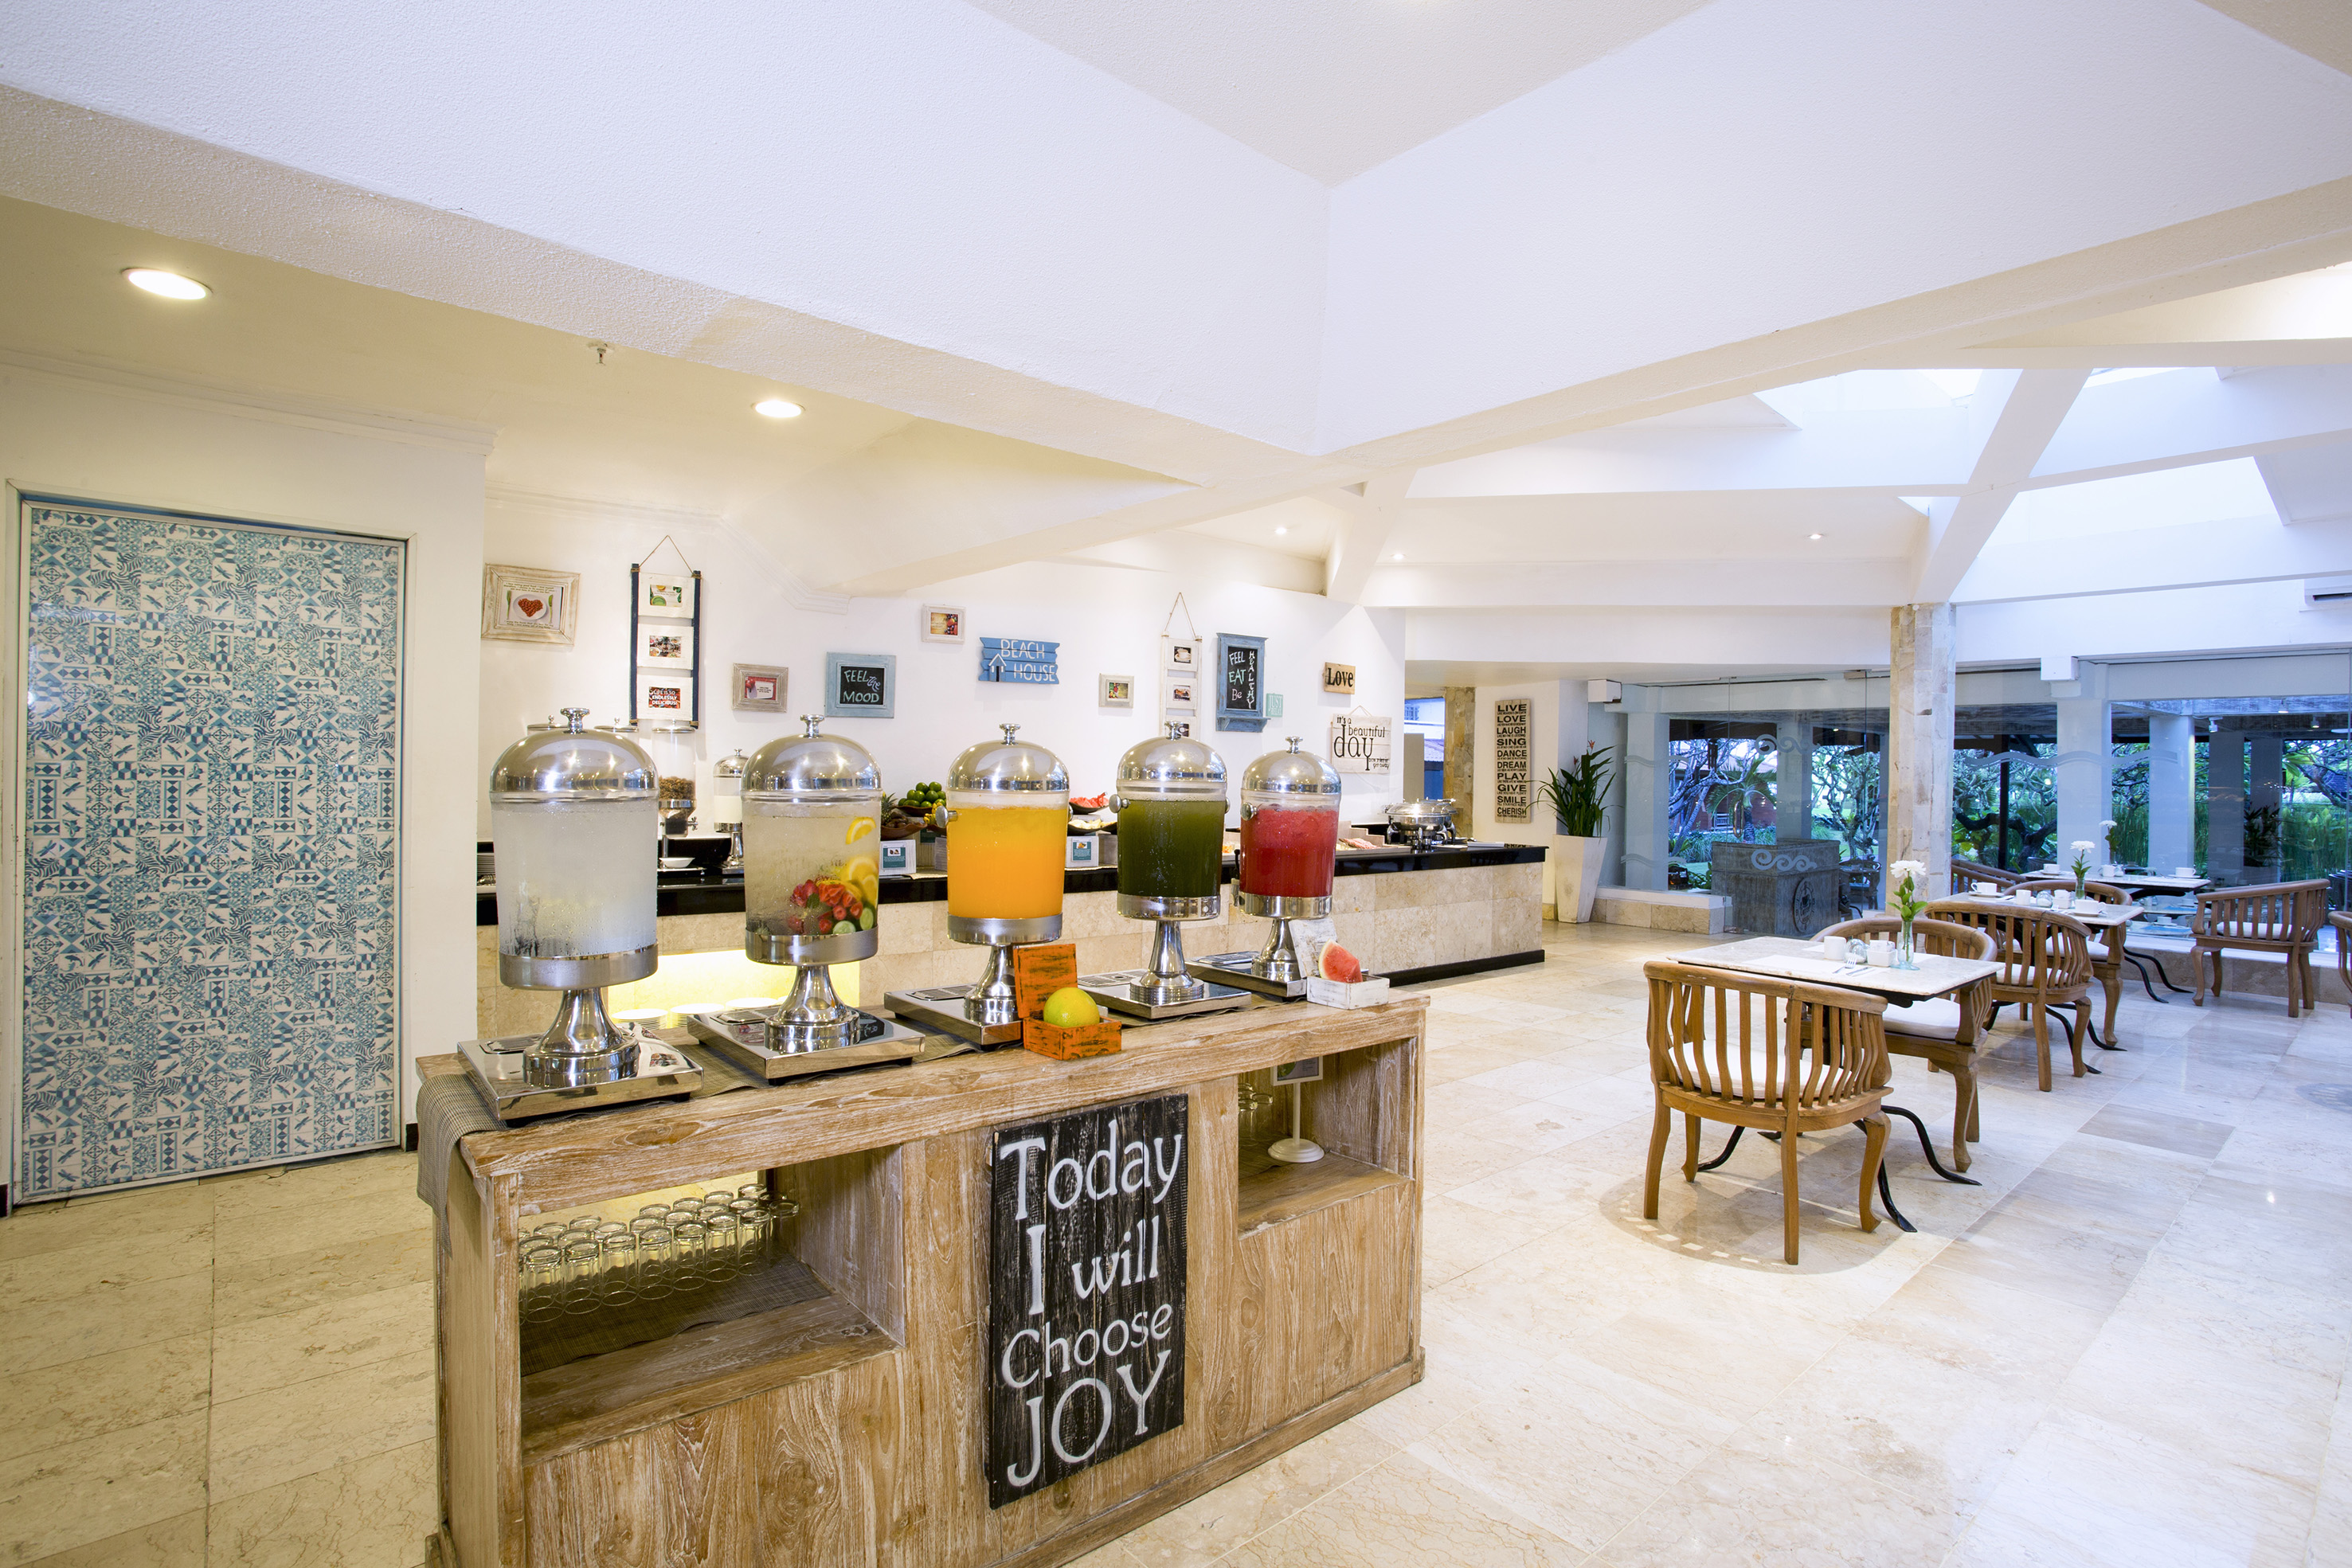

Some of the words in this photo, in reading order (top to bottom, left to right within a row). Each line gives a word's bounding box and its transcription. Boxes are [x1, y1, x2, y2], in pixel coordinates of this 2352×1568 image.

[1000, 639, 1045, 659] BEACH
[1229, 651, 1246, 666] FEEL
[843, 670, 869, 682] FEEL
[1013, 663, 1055, 682] HOUSE
[1228, 668, 1246, 685] EAT
[1246, 651, 1255, 709] HEALTHY
[1327, 667, 1354, 687] Love
[843, 690, 880, 702] MOOD
[1231, 688, 1243, 701] Be
[1268, 695, 1282, 712] JUST
[1497, 703, 1527, 712] LIVE
[1336, 715, 1347, 724] it's
[1497, 714, 1526, 723] LOVE
[1348, 725, 1385, 737] beautiful
[1333, 724, 1374, 771] day
[1497, 807, 1527, 815] CHERISH
[1000, 1119, 1182, 1221] Today
[1026, 1224, 1046, 1315] I
[1072, 1215, 1160, 1300] will
[1007, 1349, 1172, 1487] JOY
